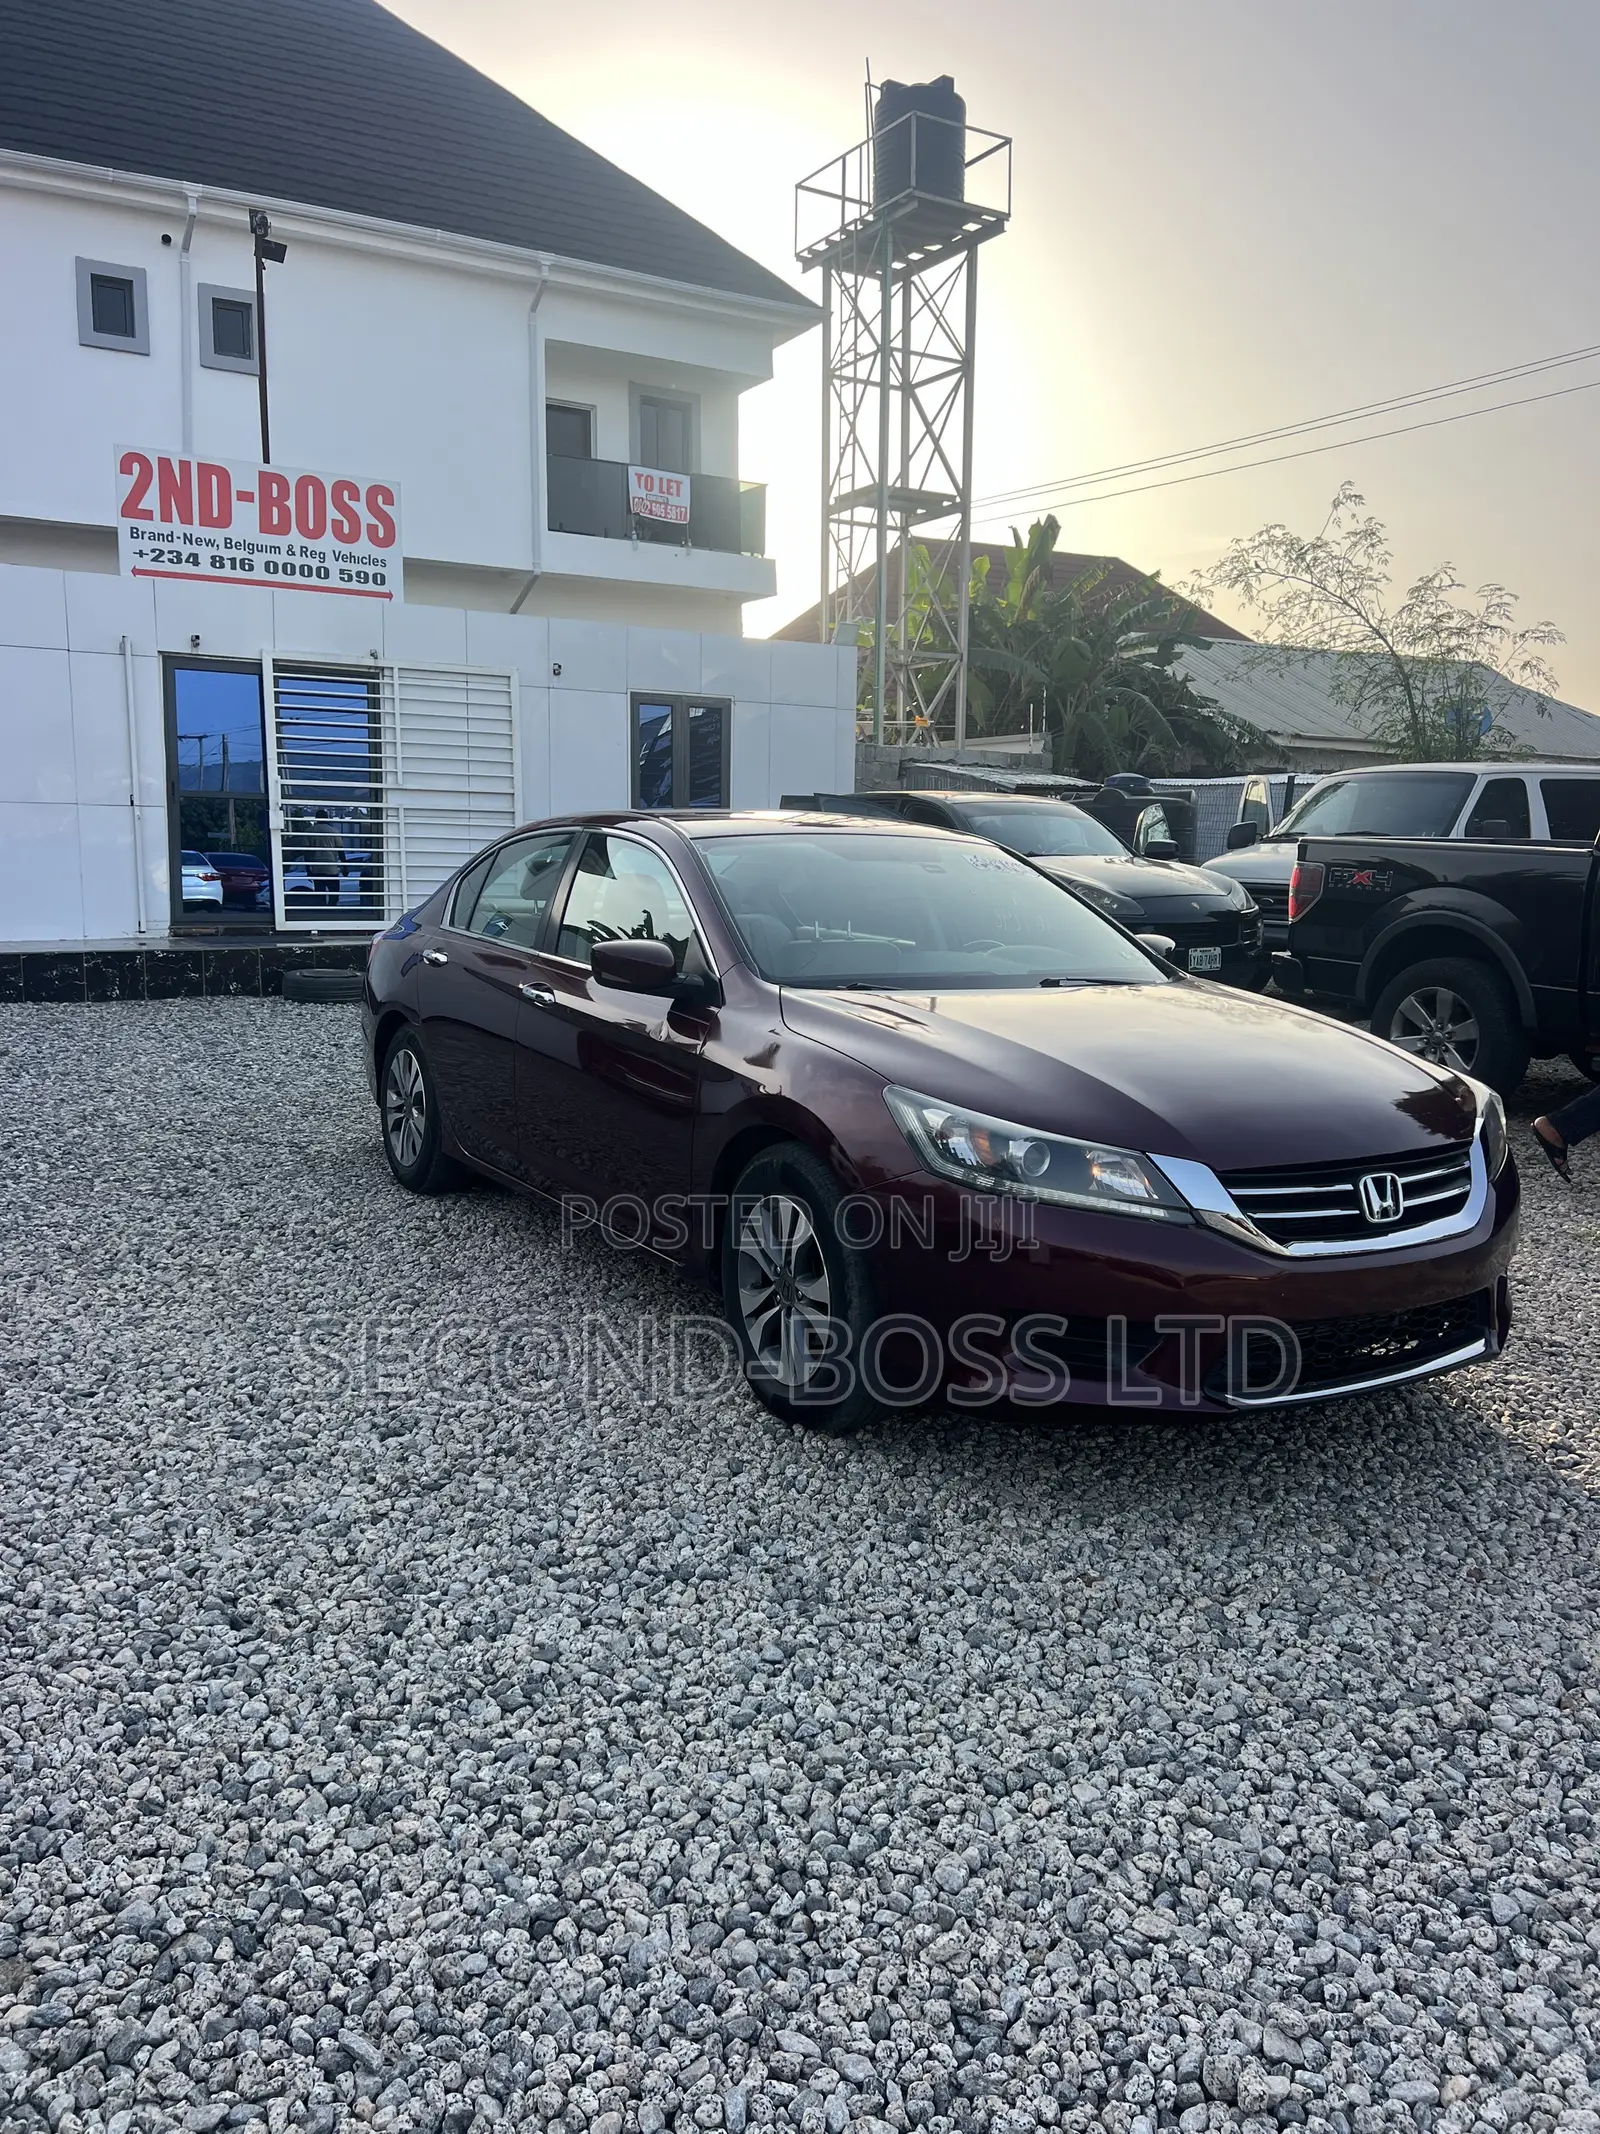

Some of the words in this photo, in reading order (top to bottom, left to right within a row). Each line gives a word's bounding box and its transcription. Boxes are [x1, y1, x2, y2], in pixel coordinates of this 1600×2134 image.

[119, 451, 396, 548] 2ND-BOSS
[634, 472, 654, 493] TO
[658, 477, 683, 497] LET
[129, 526, 220, 550] Brand-New,
[224, 537, 281, 555] Belguim
[287, 544, 296, 556] &
[300, 546, 326, 563] Reg
[332, 550, 387, 568] Vehicles
[133, 548, 201, 567] +234
[210, 555, 254, 572] 816
[264, 560, 330, 580] 0000
[339, 568, 386, 586] 590
[1328, 867, 1393, 887] FX4
